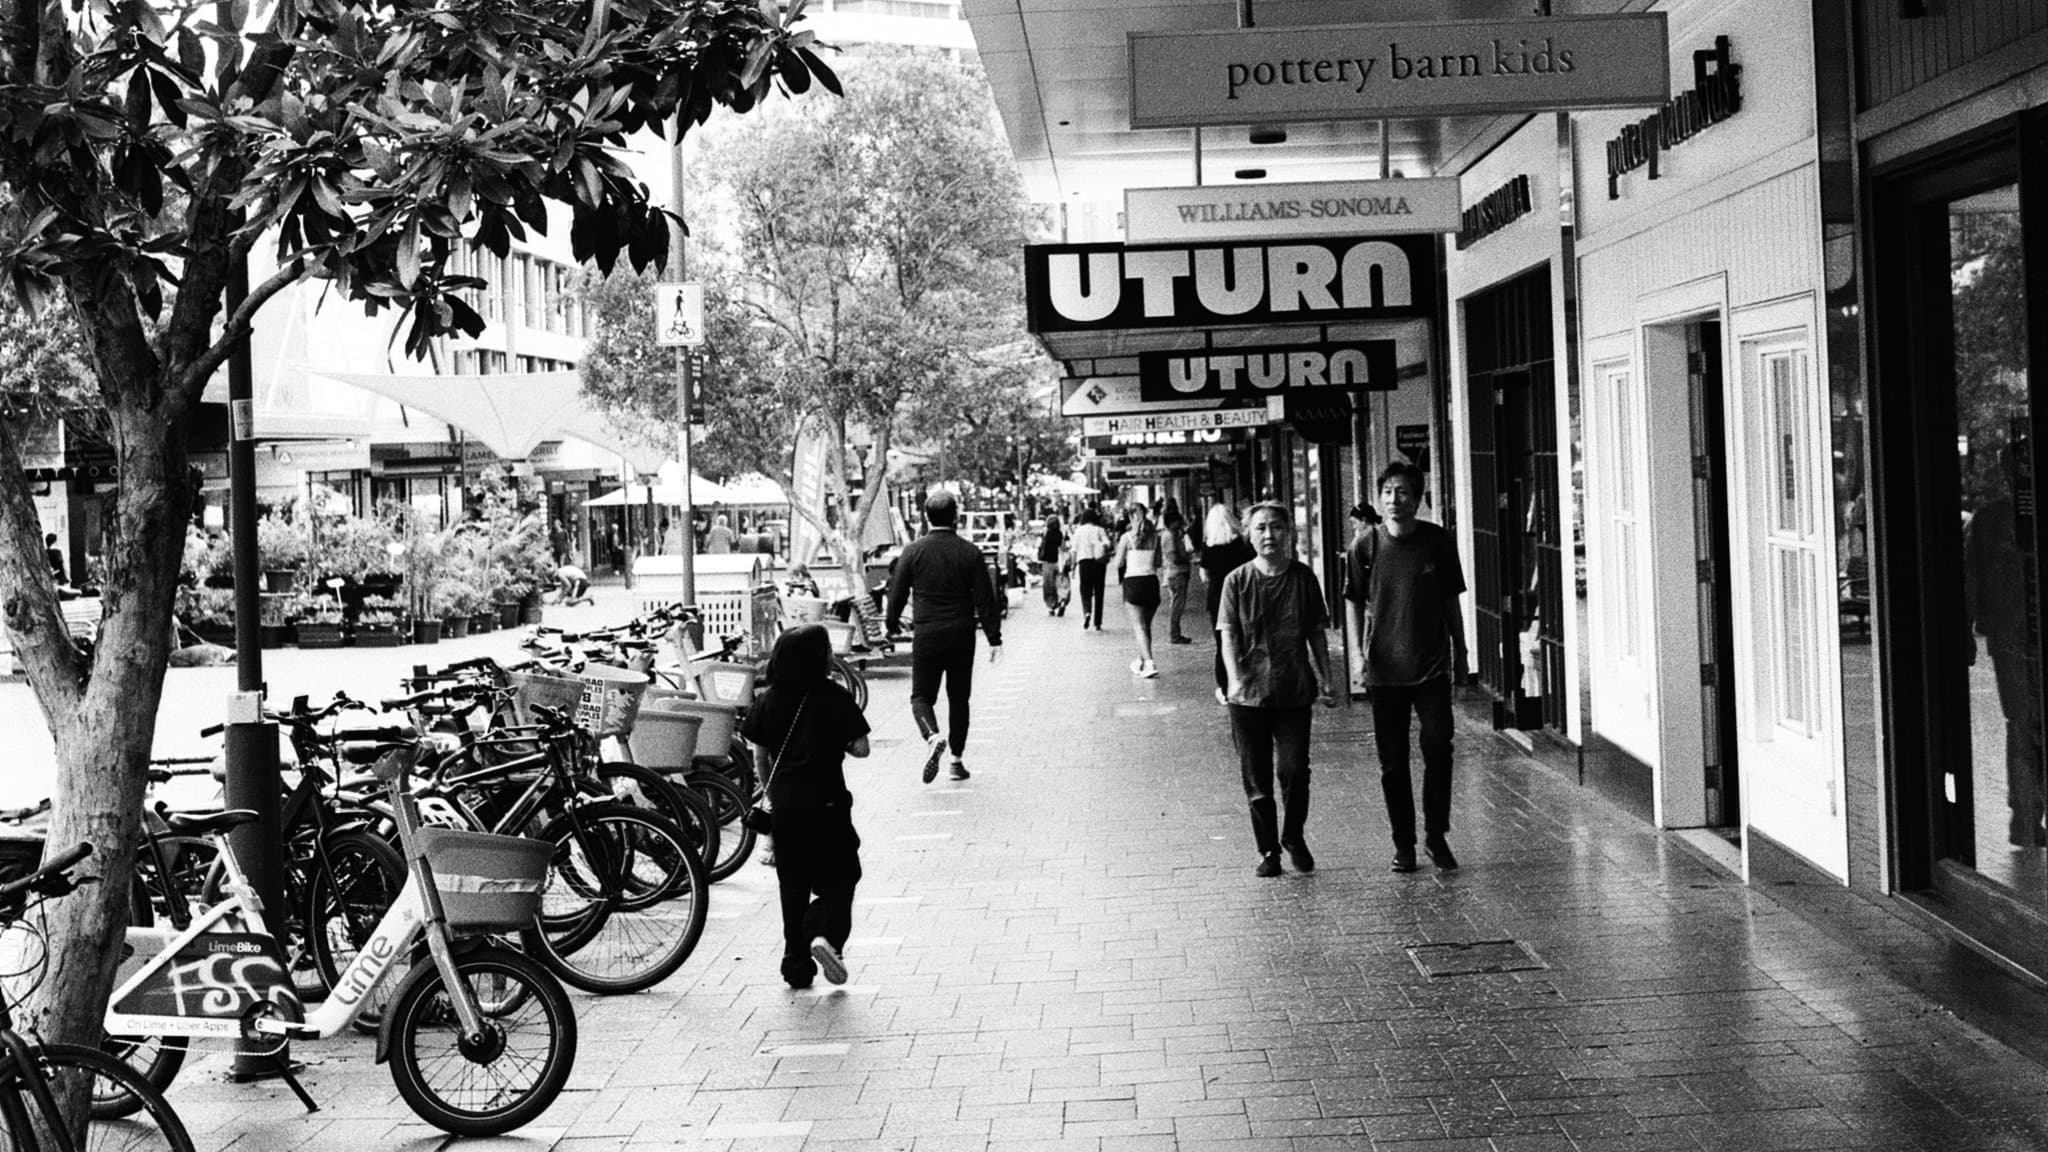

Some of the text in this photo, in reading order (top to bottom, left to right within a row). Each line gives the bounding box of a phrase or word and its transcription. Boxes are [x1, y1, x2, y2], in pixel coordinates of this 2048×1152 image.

[1227, 39, 1575, 99] pottery barn kids
[1177, 197, 1412, 223] WILLIAMS-SONOMA
[1109, 418, 1142, 432] HAIR
[1145, 415, 1197, 430] HEALTH
[1201, 414, 1210, 426] &
[1214, 410, 1267, 425] BEAUTY
[208, 940, 262, 953] LimeBike
[333, 935, 393, 1005] Lime
